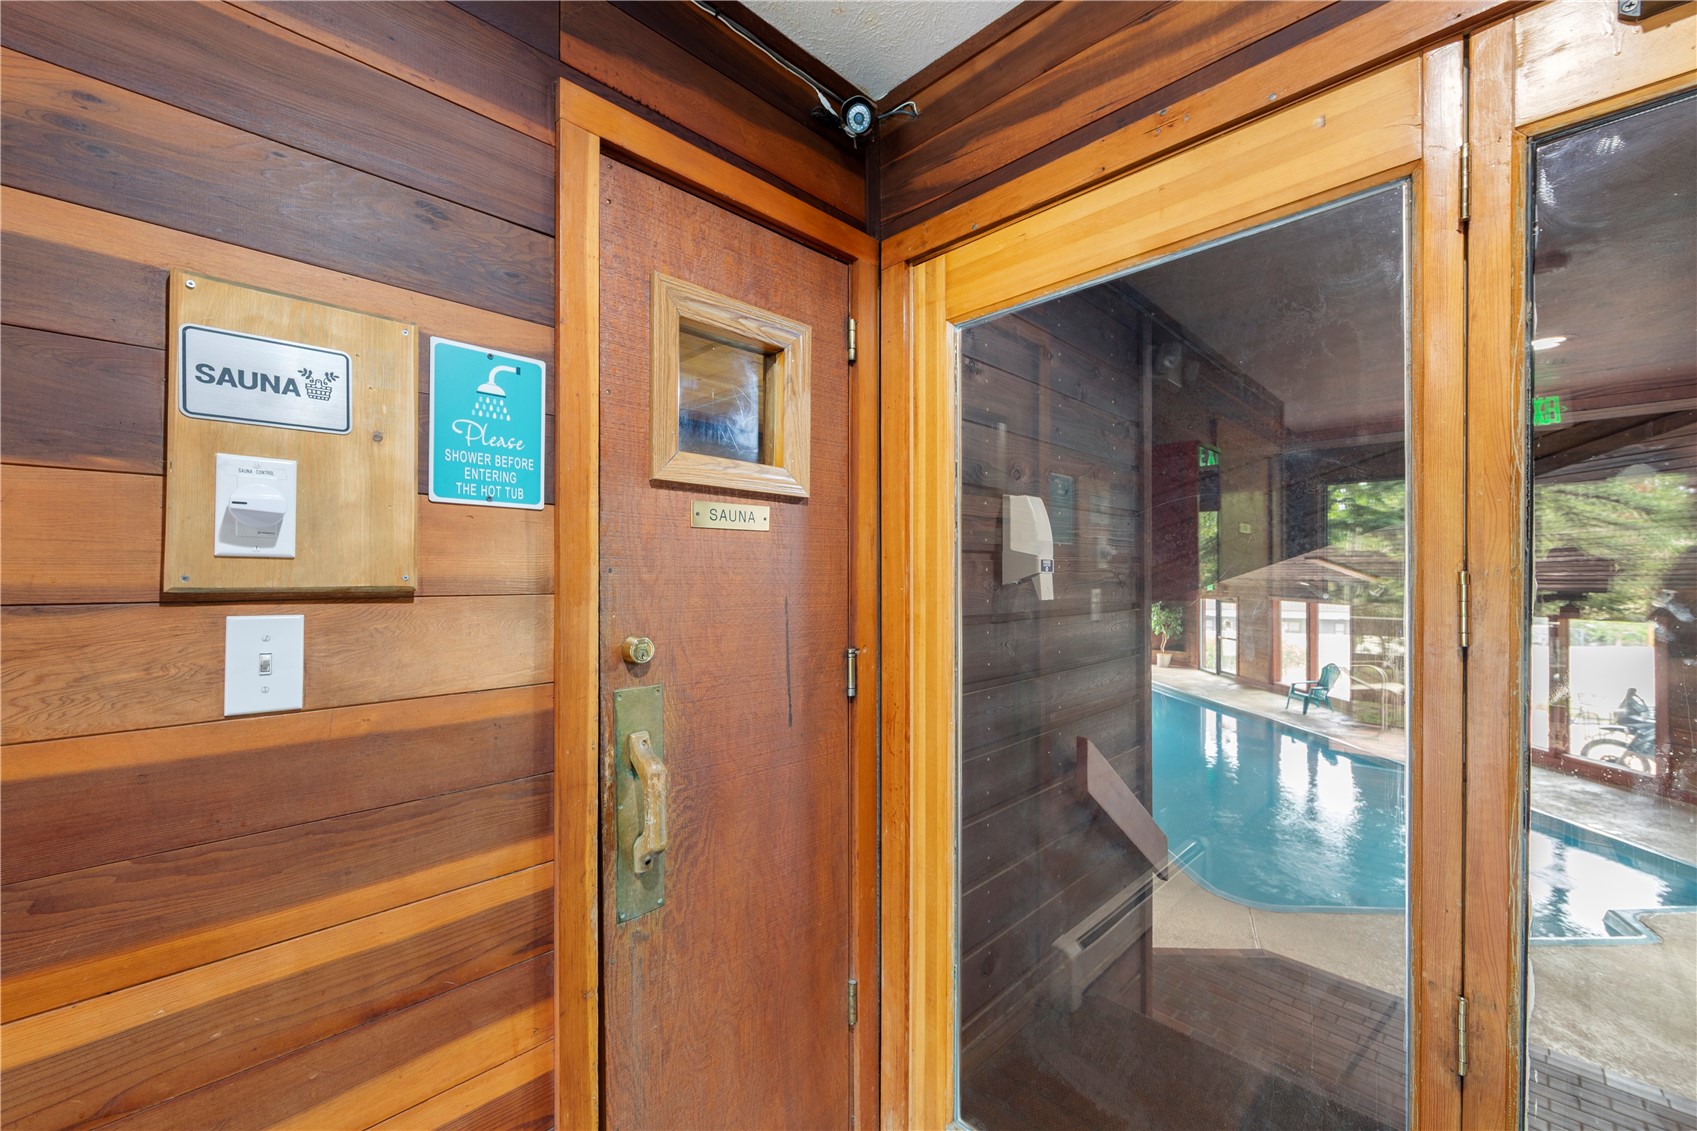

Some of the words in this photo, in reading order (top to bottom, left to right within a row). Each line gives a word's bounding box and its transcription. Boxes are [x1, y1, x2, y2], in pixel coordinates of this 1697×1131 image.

[195, 363, 301, 398] SAUNA
[451, 418, 526, 451] Please
[444, 448, 492, 466] SHOWER
[494, 455, 534, 471] BEFORE
[464, 467, 517, 484] ENTERING
[456, 482, 477, 496] THE
[480, 485, 502, 498] HOT
[505, 487, 524, 500] TUB
[709, 508, 756, 524] SAUNA
